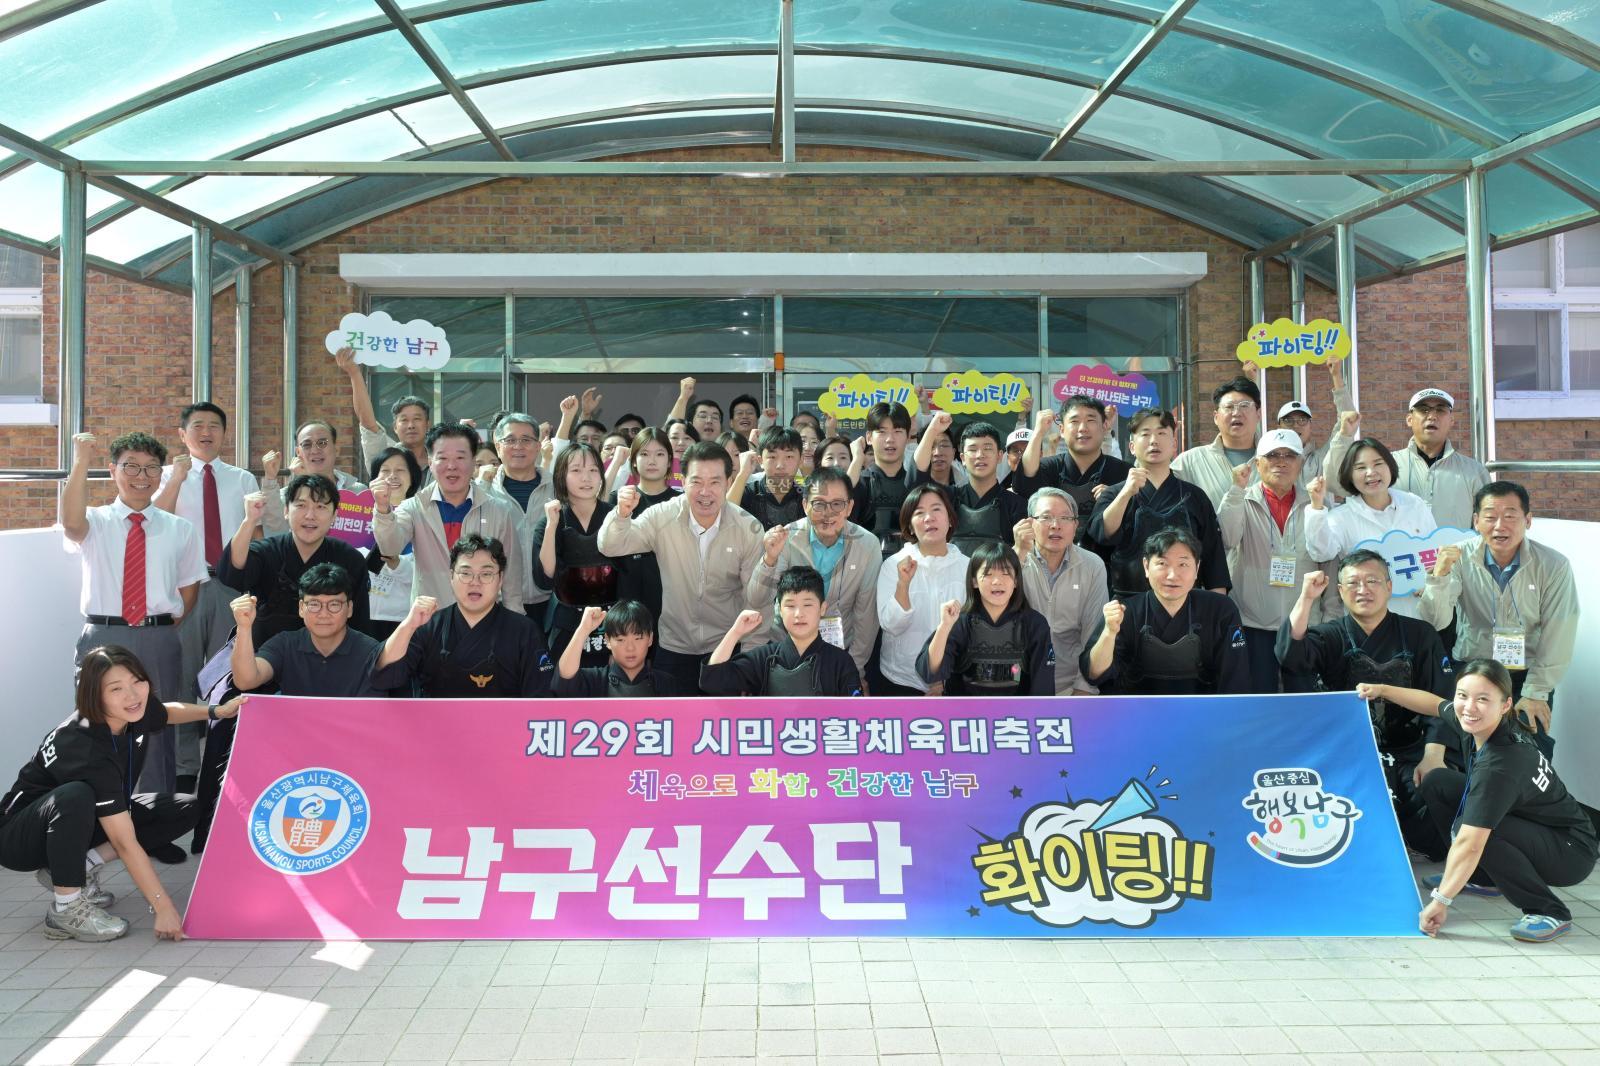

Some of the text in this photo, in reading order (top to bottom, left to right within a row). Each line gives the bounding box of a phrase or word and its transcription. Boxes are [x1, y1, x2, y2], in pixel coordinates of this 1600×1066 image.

[345, 331, 440, 356] 건강한 남구
[1257, 329, 1339, 356] 파이팅!!
[951, 382, 1021, 406] 파이팅!!
[1096, 389, 1130, 404] 하나되는
[330, 516, 364, 534] 체전의
[1386, 553, 1420, 580] 구
[527, 717, 1075, 758] 제29회 시민생활체육대축전
[628, 767, 979, 802] 체육으로 화합, 건강한 남구
[1261, 771, 1310, 787] 울산중심
[254, 819, 363, 870] ULSAN NAMGU SPORTS COUNCIL
[396, 820, 913, 921] 남구선수단
[972, 829, 1213, 906] 화이팅!!
